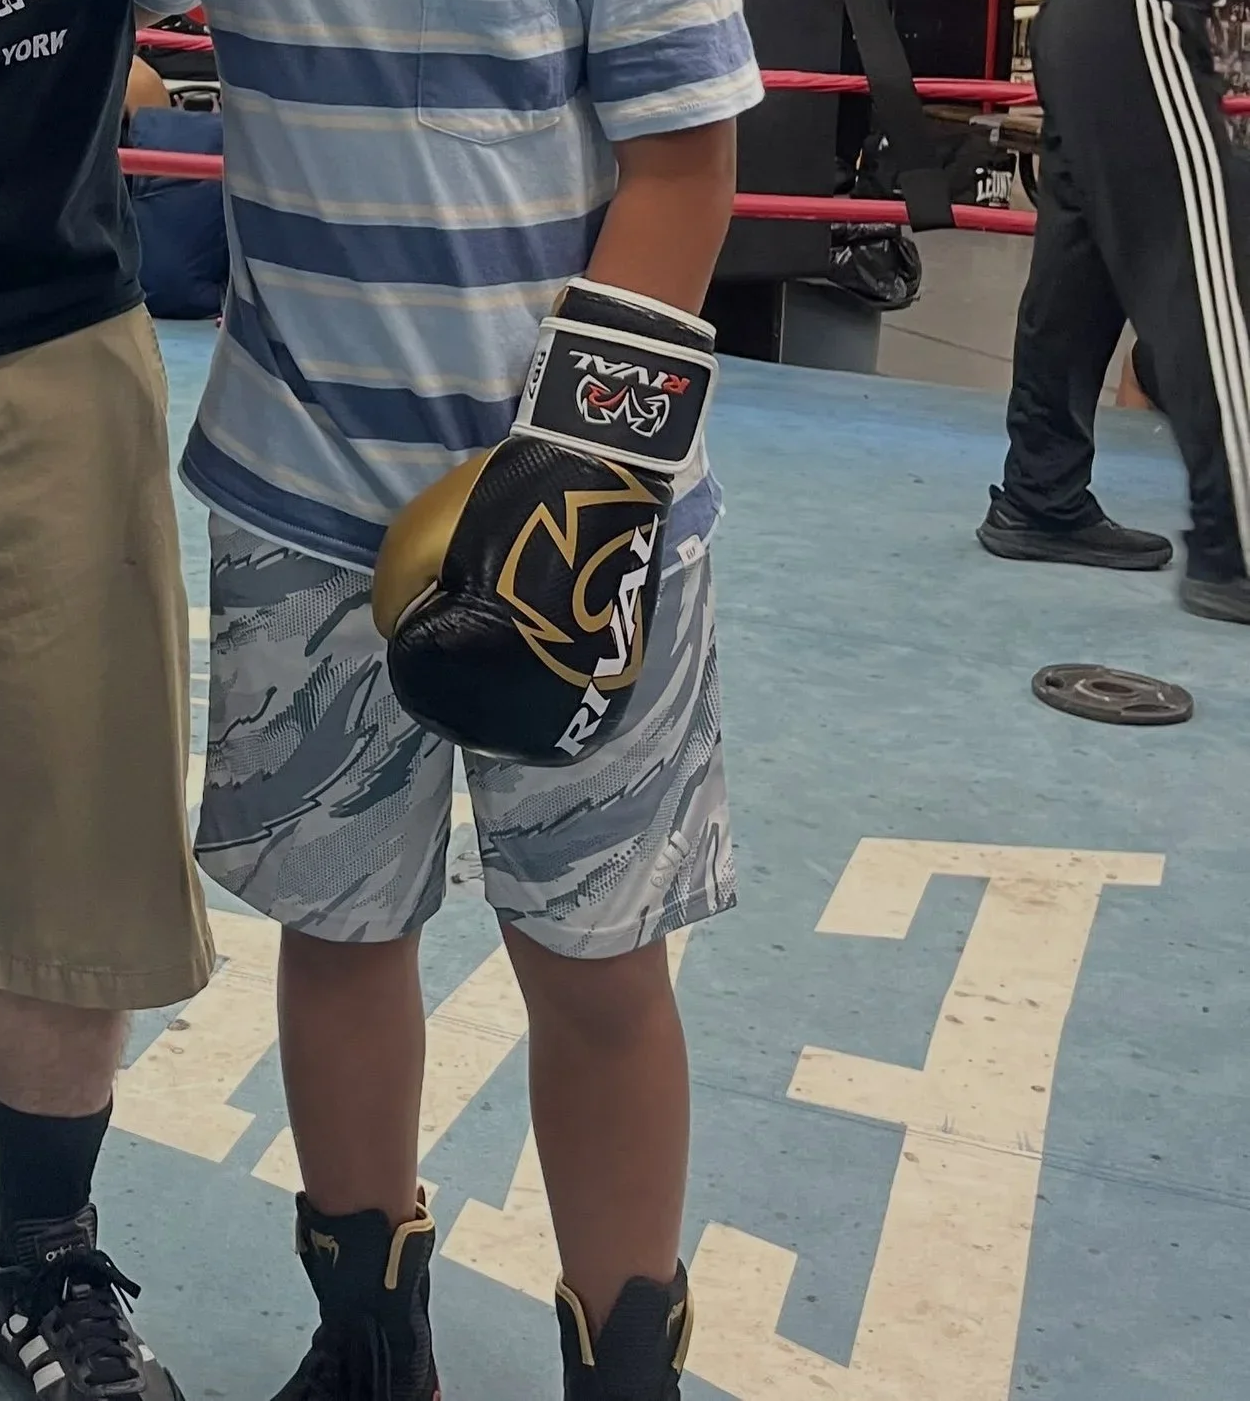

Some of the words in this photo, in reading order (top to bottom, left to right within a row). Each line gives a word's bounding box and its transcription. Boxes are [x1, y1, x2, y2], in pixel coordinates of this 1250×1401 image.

[0, 29, 69, 69] YORK
[568, 349, 690, 395] RIVAL
[554, 514, 660, 758] RIVAL
